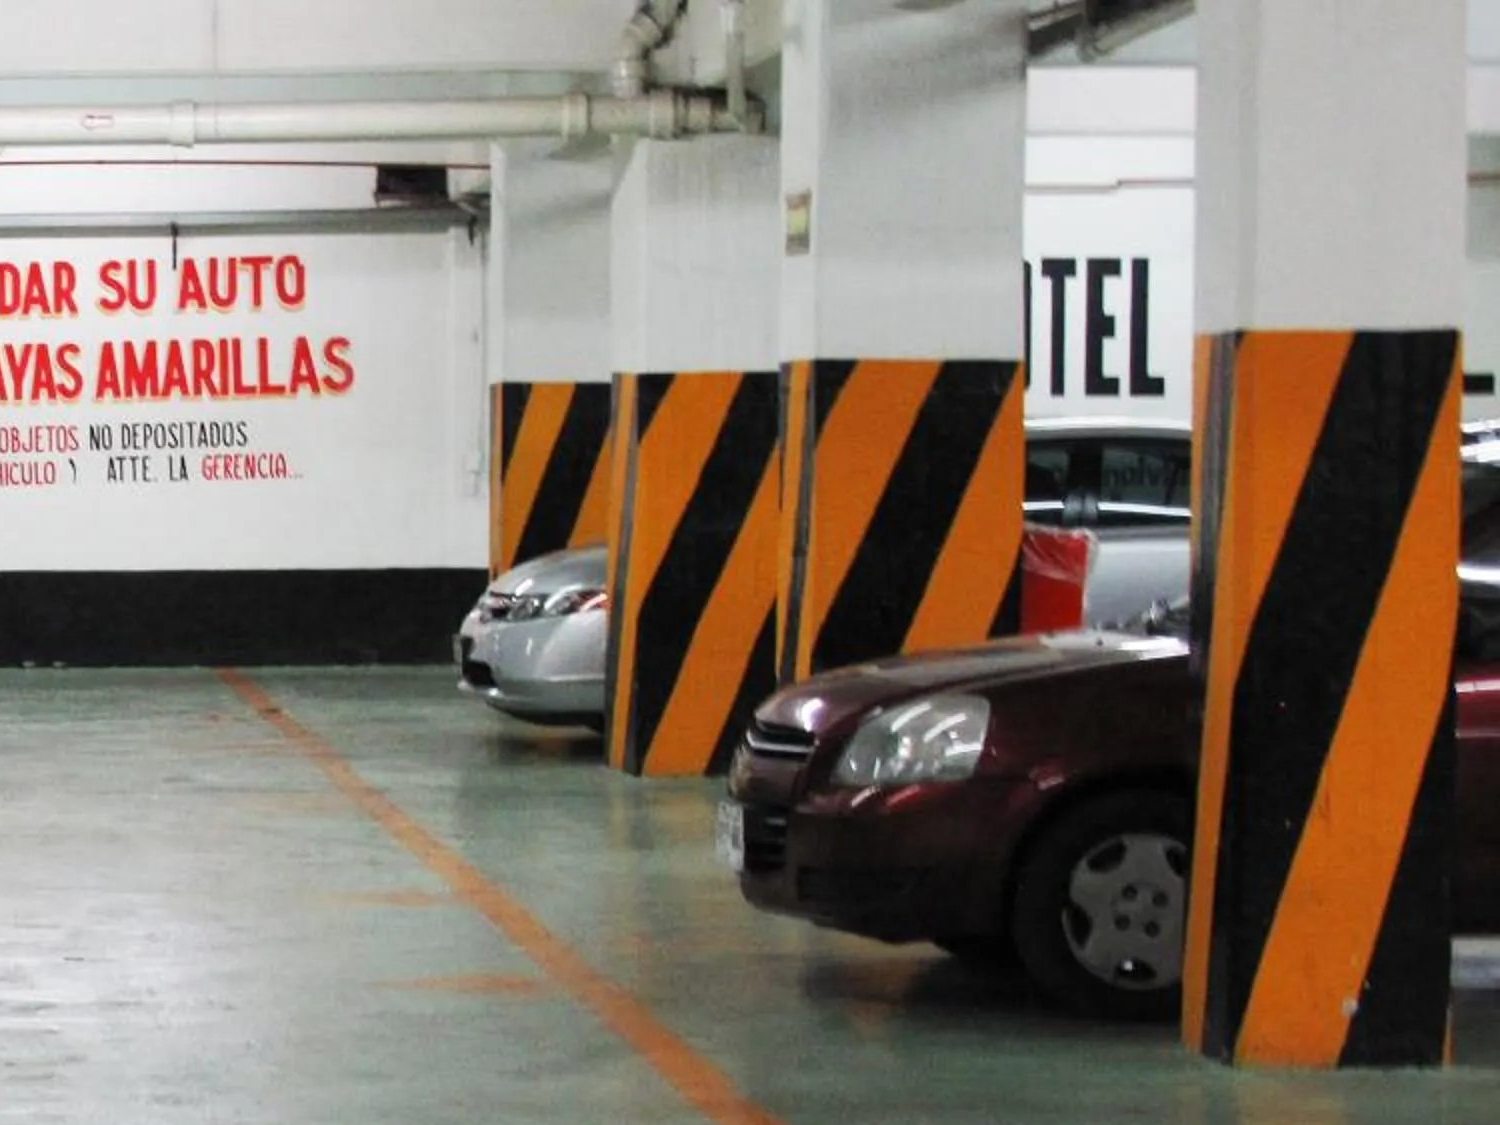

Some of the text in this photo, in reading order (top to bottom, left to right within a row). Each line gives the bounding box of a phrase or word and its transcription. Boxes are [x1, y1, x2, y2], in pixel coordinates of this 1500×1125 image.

[98, 259, 156, 313] SU
[178, 255, 307, 311] AUTO
[1024, 258, 1164, 396] TEL
[95, 336, 356, 400] AMARILLAS
[89, 424, 113, 451] NO
[121, 420, 248, 450] DEPOSITADOS
[169, 456, 189, 481] LA
